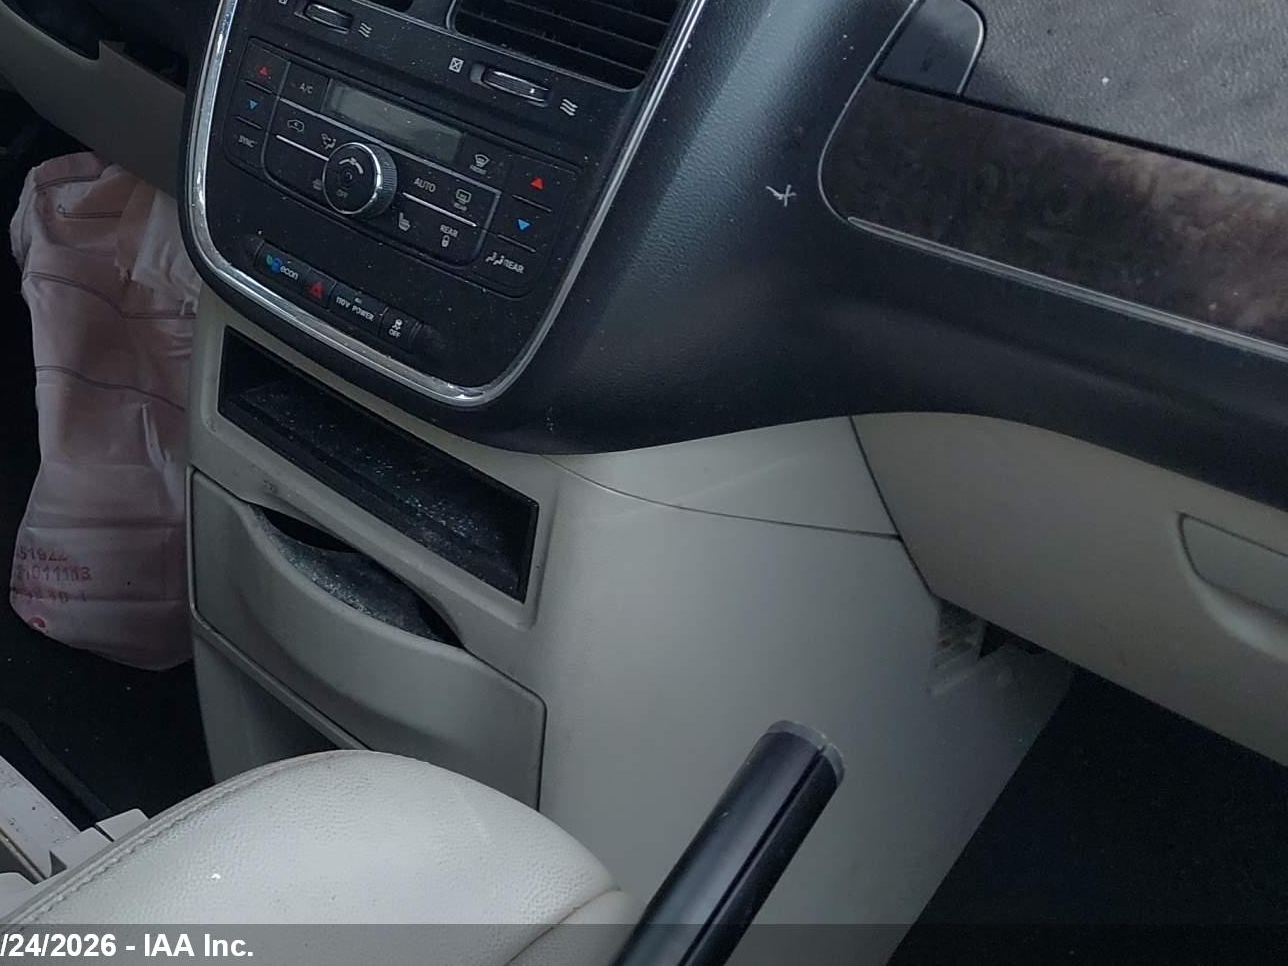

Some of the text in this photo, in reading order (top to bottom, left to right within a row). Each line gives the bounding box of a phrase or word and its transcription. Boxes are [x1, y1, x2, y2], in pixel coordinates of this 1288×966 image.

[413, 177, 437, 193] AUTO
[440, 224, 459, 238] REAR
[280, 265, 299, 281] econ
[503, 258, 525, 274] REAR
[335, 296, 375, 322] 110V POWER
[388, 328, 402, 339] OFF
